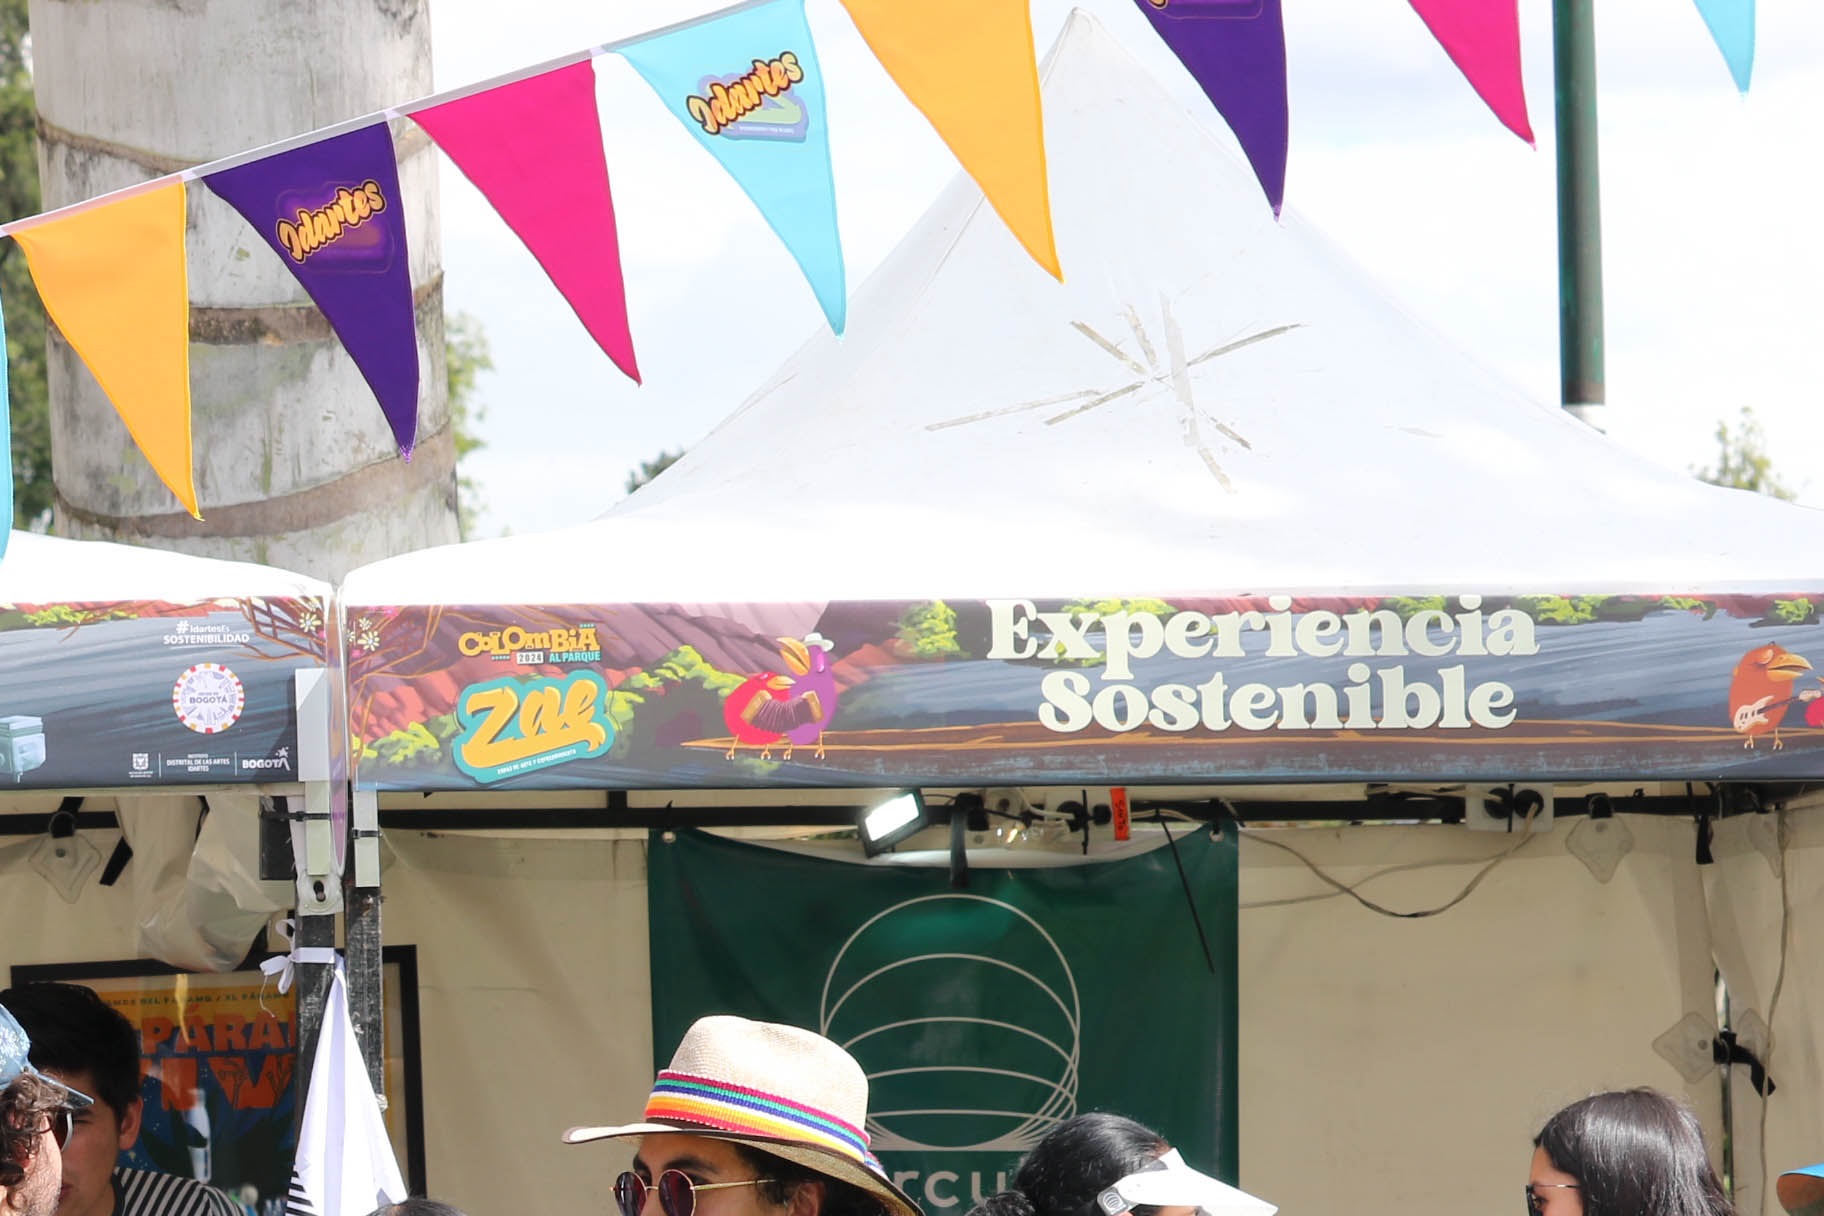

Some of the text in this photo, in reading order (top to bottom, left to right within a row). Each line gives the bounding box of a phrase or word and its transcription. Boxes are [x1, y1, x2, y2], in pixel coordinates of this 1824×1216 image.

[163, 632, 250, 645] SOSTENIBILIDAD
[549, 651, 601, 663] AL PARQUE
[987, 595, 1541, 681] Experiencia
[1038, 662, 1520, 733] Sostenible
